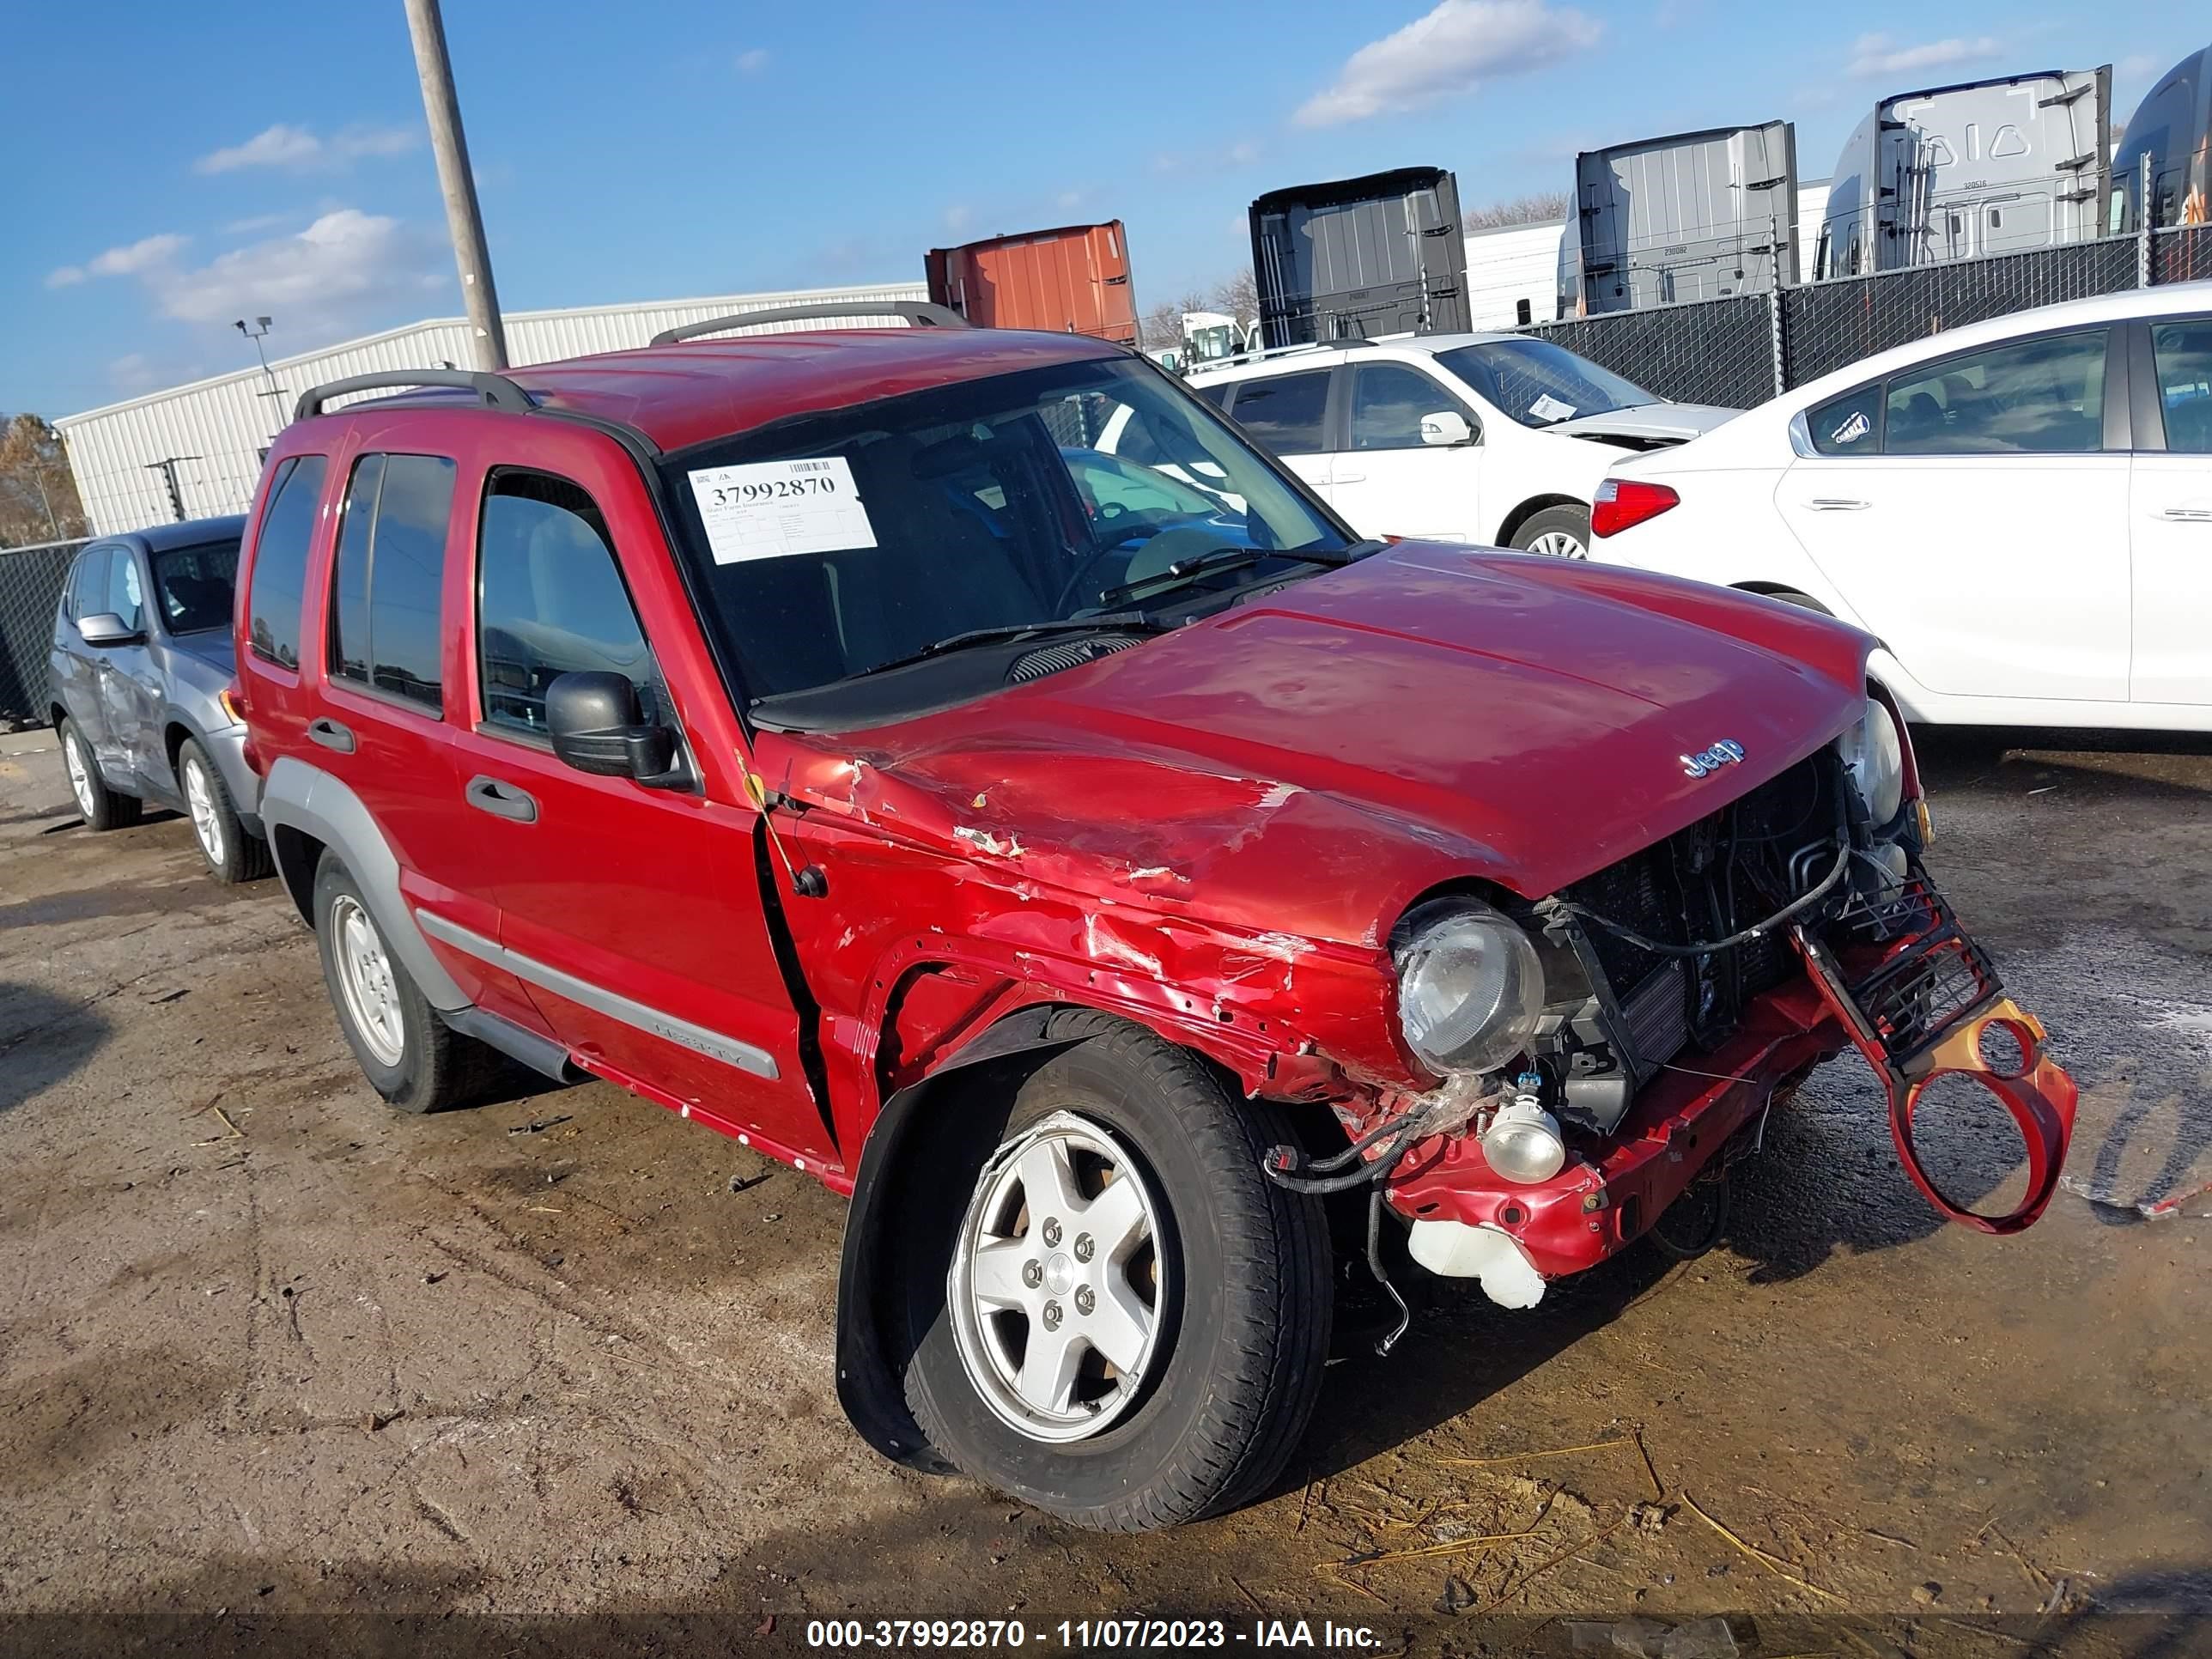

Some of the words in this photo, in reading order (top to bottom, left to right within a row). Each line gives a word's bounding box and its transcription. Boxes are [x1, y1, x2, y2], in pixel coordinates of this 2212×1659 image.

[1963, 179, 1987, 190] 320516
[1664, 246, 1687, 257] 230082
[711, 476, 836, 507] 37992870
[1679, 738, 1745, 779] Jeep
